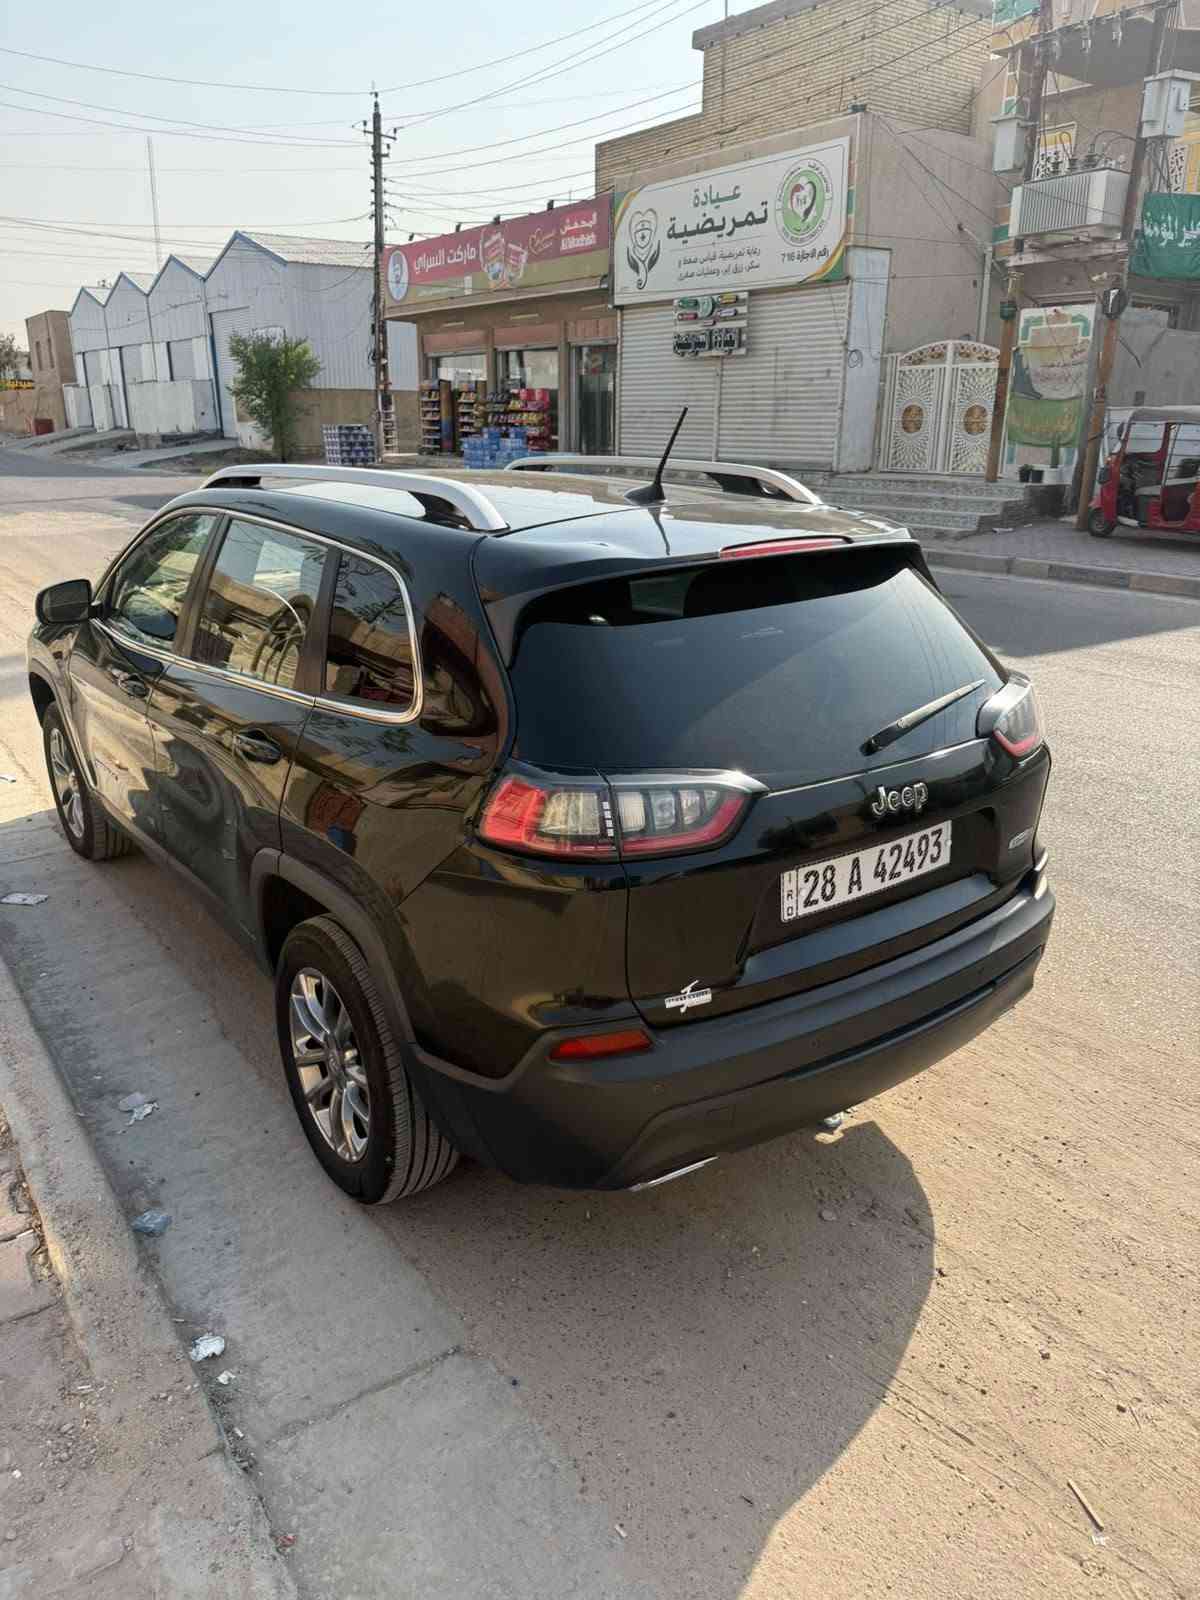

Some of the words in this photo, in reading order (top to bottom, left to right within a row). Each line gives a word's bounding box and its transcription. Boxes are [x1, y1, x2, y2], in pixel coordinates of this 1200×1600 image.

[692, 184, 741, 209] عيادة
[666, 200, 768, 244] تمريضية
[414, 247, 446, 275] السراي
[447, 243, 477, 265] ماركت
[871, 782, 929, 816] Jeep
[802, 863, 838, 909] 28
[847, 856, 863, 895] A
[873, 827, 943, 884] 42493
